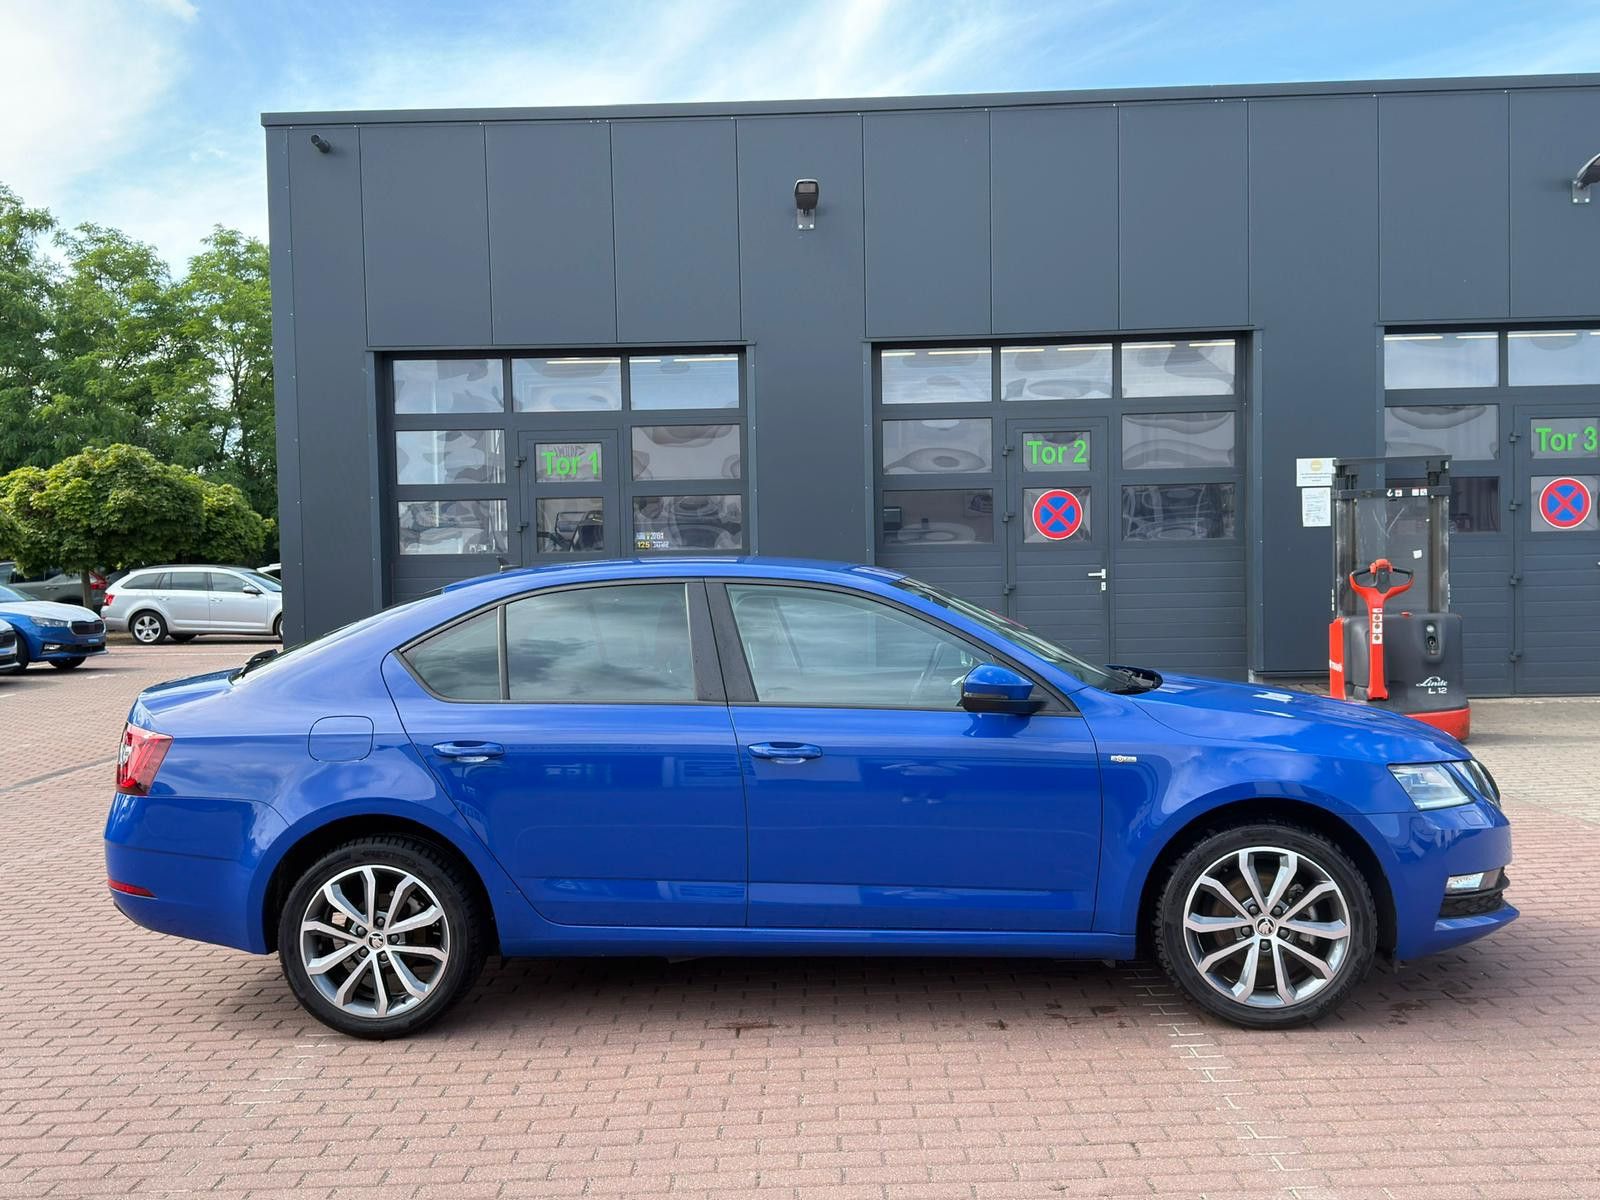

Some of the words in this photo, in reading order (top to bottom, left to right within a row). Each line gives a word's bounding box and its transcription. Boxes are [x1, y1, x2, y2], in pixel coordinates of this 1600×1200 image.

[1535, 427, 1578, 452] Tor
[1583, 425, 1597, 451] 3
[542, 451, 580, 475] Tor
[588, 451, 599, 476] 1
[1026, 440, 1067, 465] Tor
[1073, 439, 1088, 463] 2
